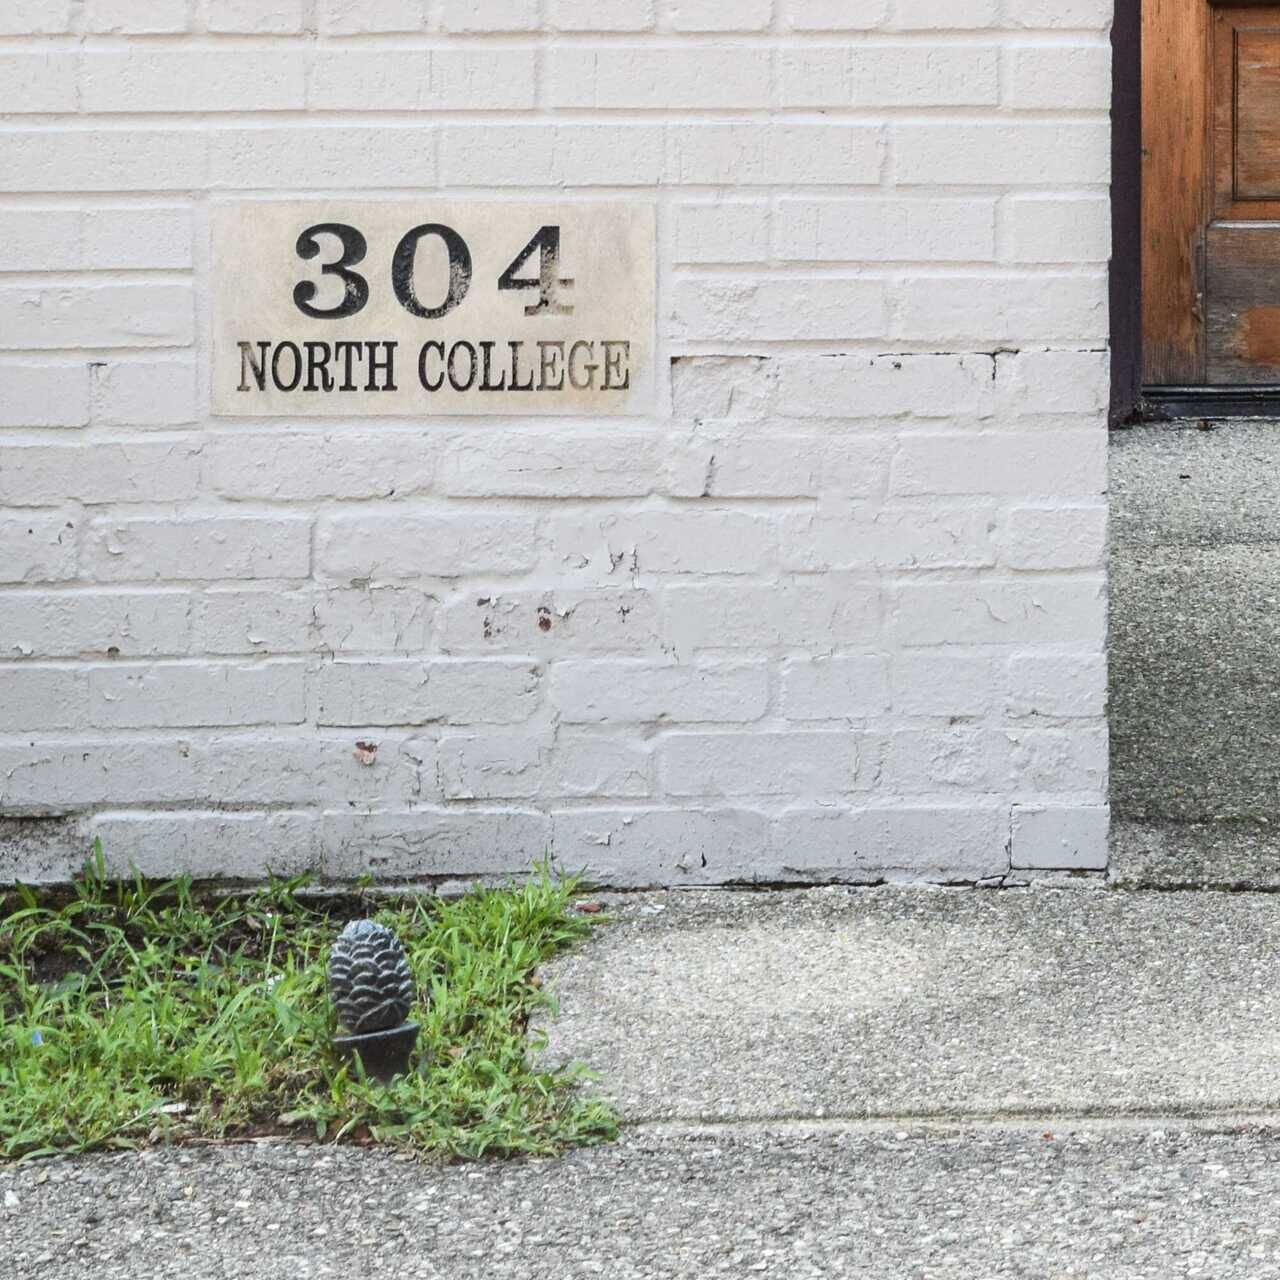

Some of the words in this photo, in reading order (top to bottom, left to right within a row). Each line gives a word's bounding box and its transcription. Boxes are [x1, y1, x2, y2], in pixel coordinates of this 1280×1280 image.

[292, 223, 575, 320] 304
[236, 340, 398, 392] NORTH
[418, 340, 630, 392] COLLEGE
